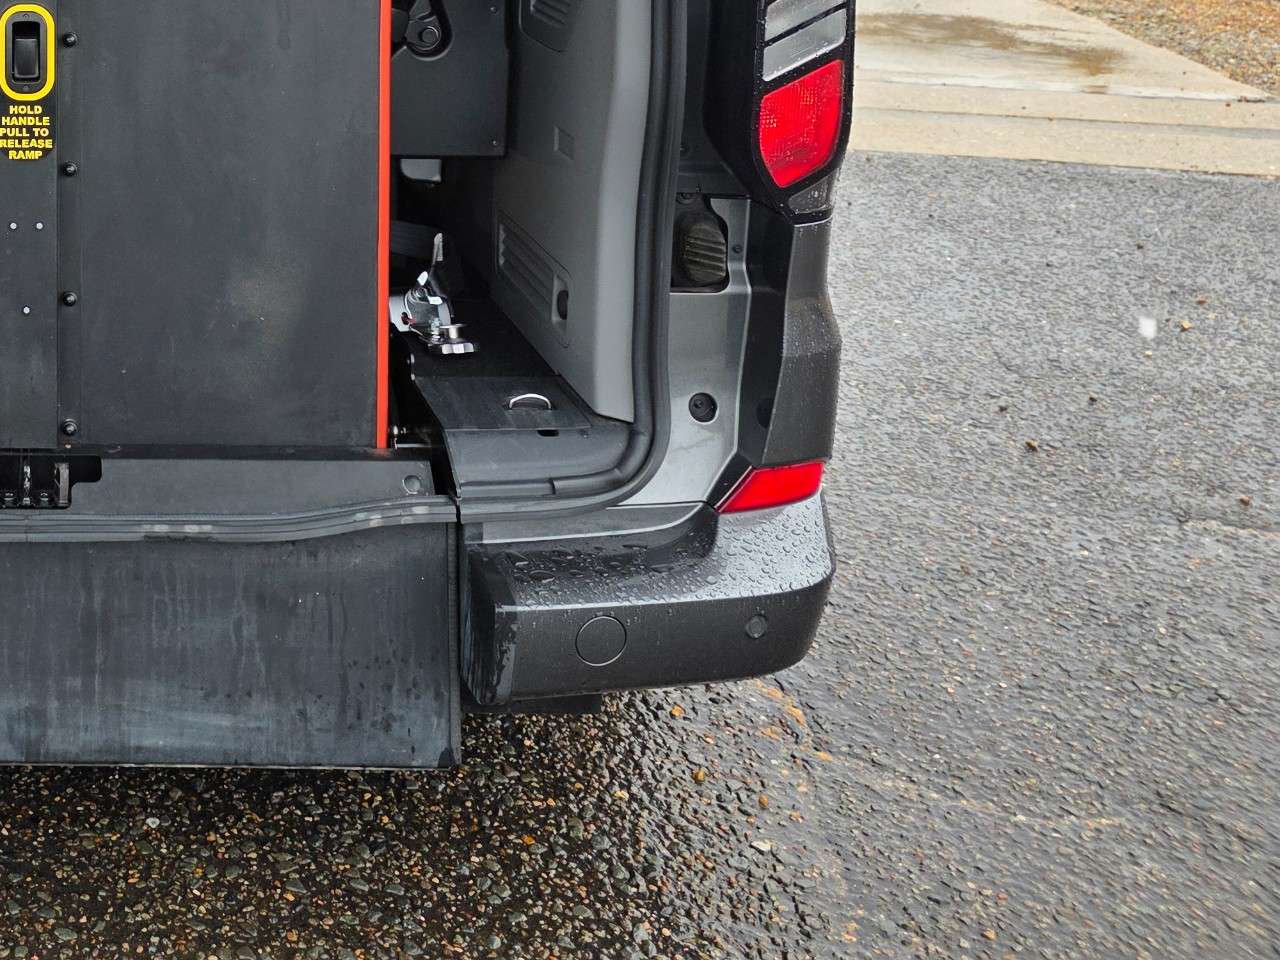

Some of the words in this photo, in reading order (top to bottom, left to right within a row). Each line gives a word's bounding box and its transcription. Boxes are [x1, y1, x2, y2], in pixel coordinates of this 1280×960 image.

[9, 105, 42, 114] HOLD
[1, 116, 50, 125] HANDLE
[0, 127, 29, 136] PULL
[33, 127, 49, 137] TO
[0, 138, 53, 148] RELEASE
[8, 150, 42, 160] RAMP
